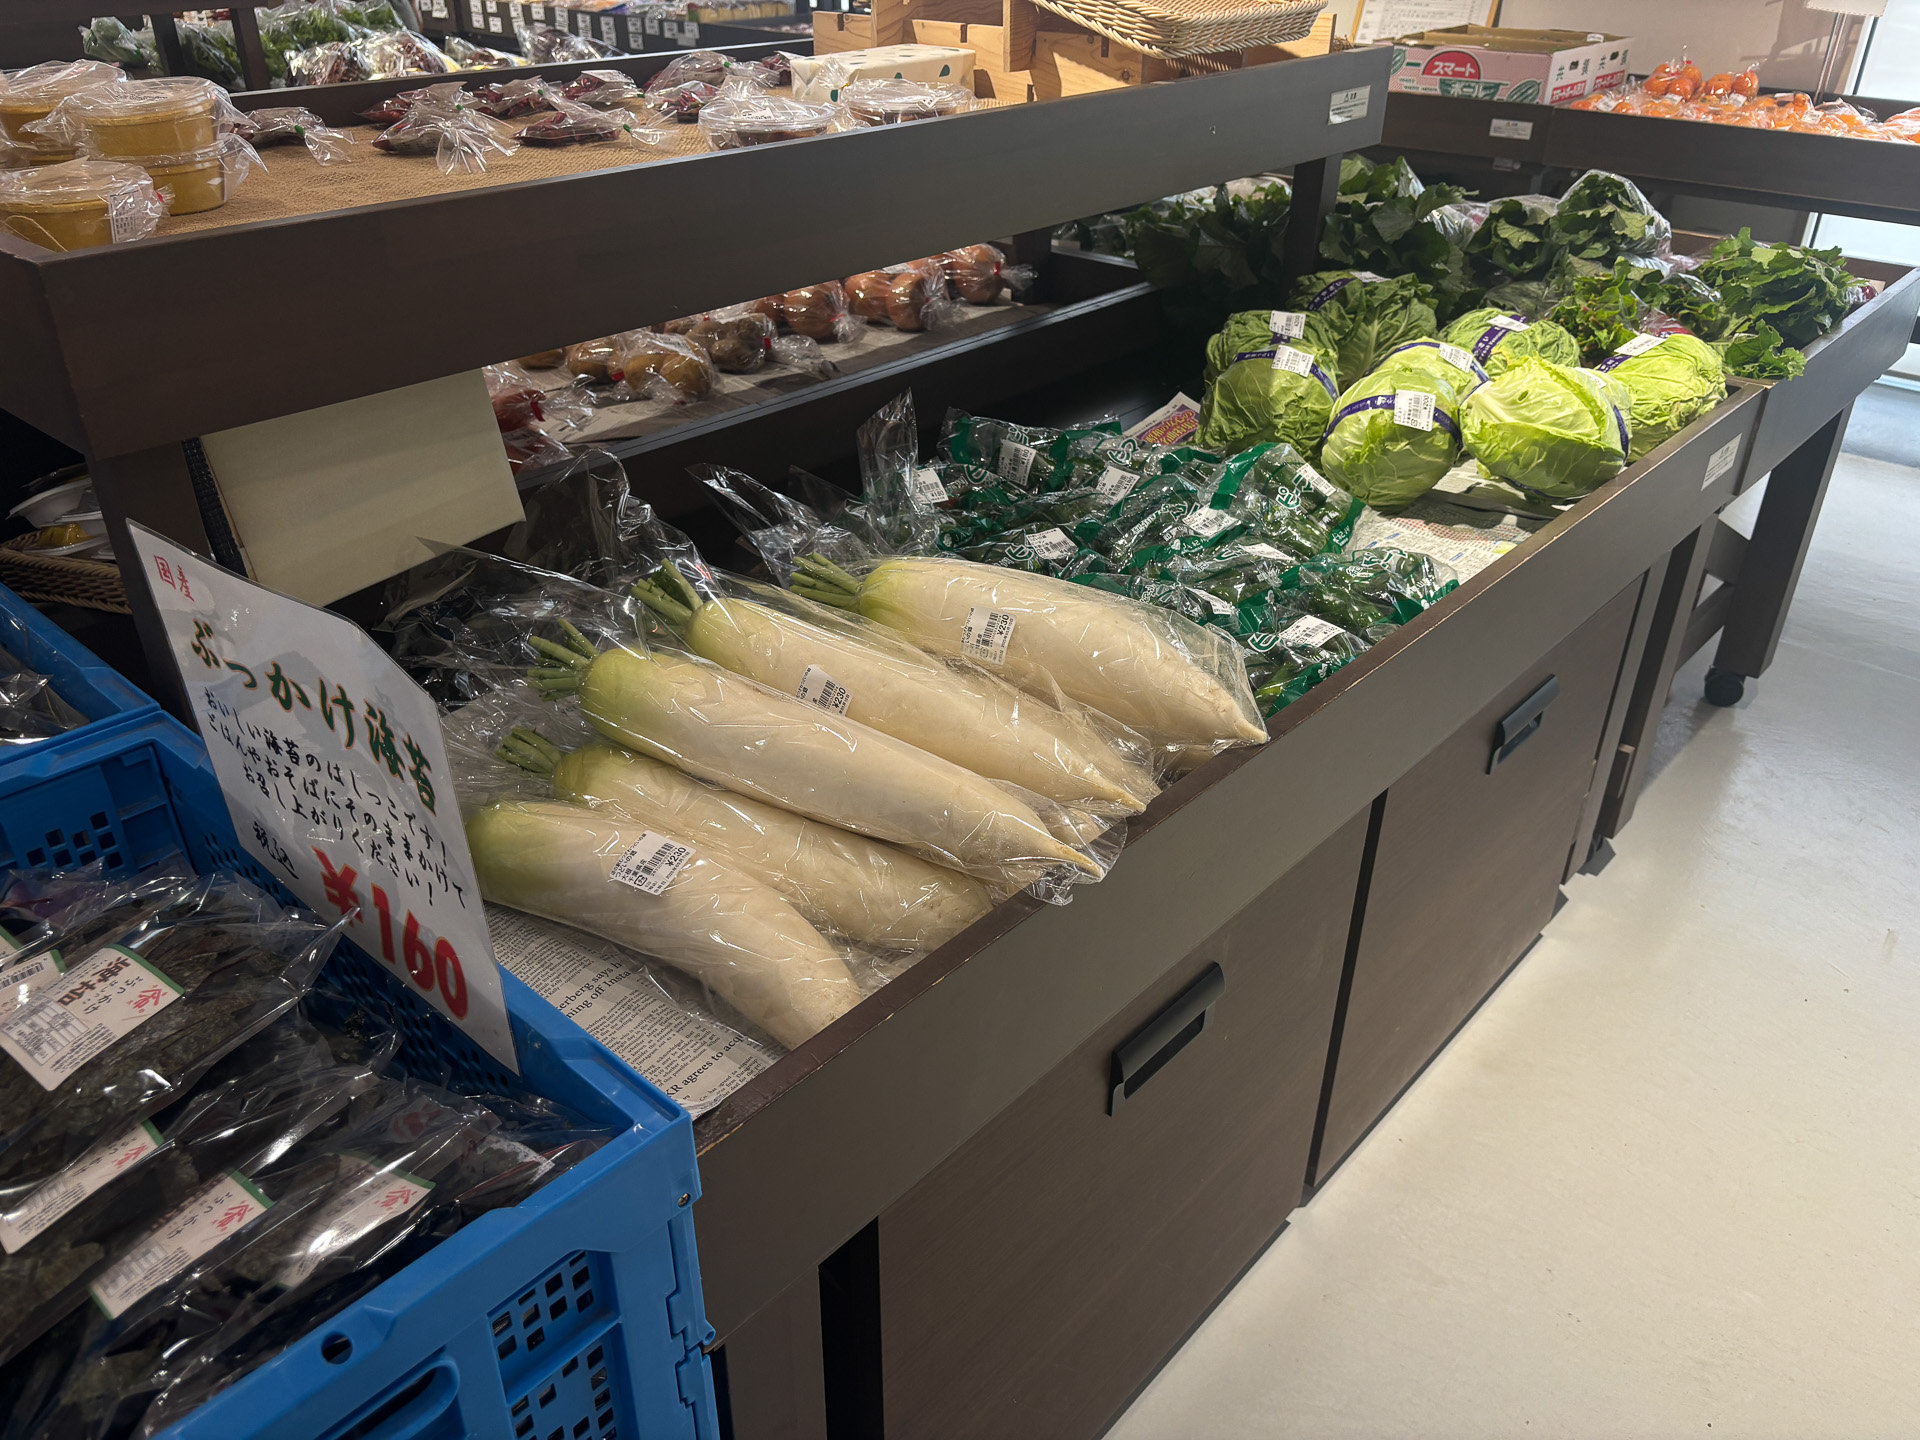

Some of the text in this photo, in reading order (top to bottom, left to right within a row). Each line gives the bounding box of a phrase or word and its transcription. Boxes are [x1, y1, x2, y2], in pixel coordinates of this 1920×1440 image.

[1432, 61, 1476, 77] スマート
[153, 555, 195, 602] 国産
[997, 614, 1010, 636] ¥230
[191, 619, 437, 813] ぶっかけ海苔
[832, 687, 847, 709] ¥230
[665, 847, 687, 867] ¥230
[312, 846, 469, 1021] ¥160
[57, 956, 132, 1007] 海苔
[588, 984, 605, 1000] off
[602, 965, 631, 991] Insta
[591, 964, 614, 985] says
[83, 975, 144, 1015] ぶっかけ
[680, 1059, 714, 1088] agrees
[710, 1049, 724, 1062] to
[167, 1191, 233, 1240] ぶっかけ
